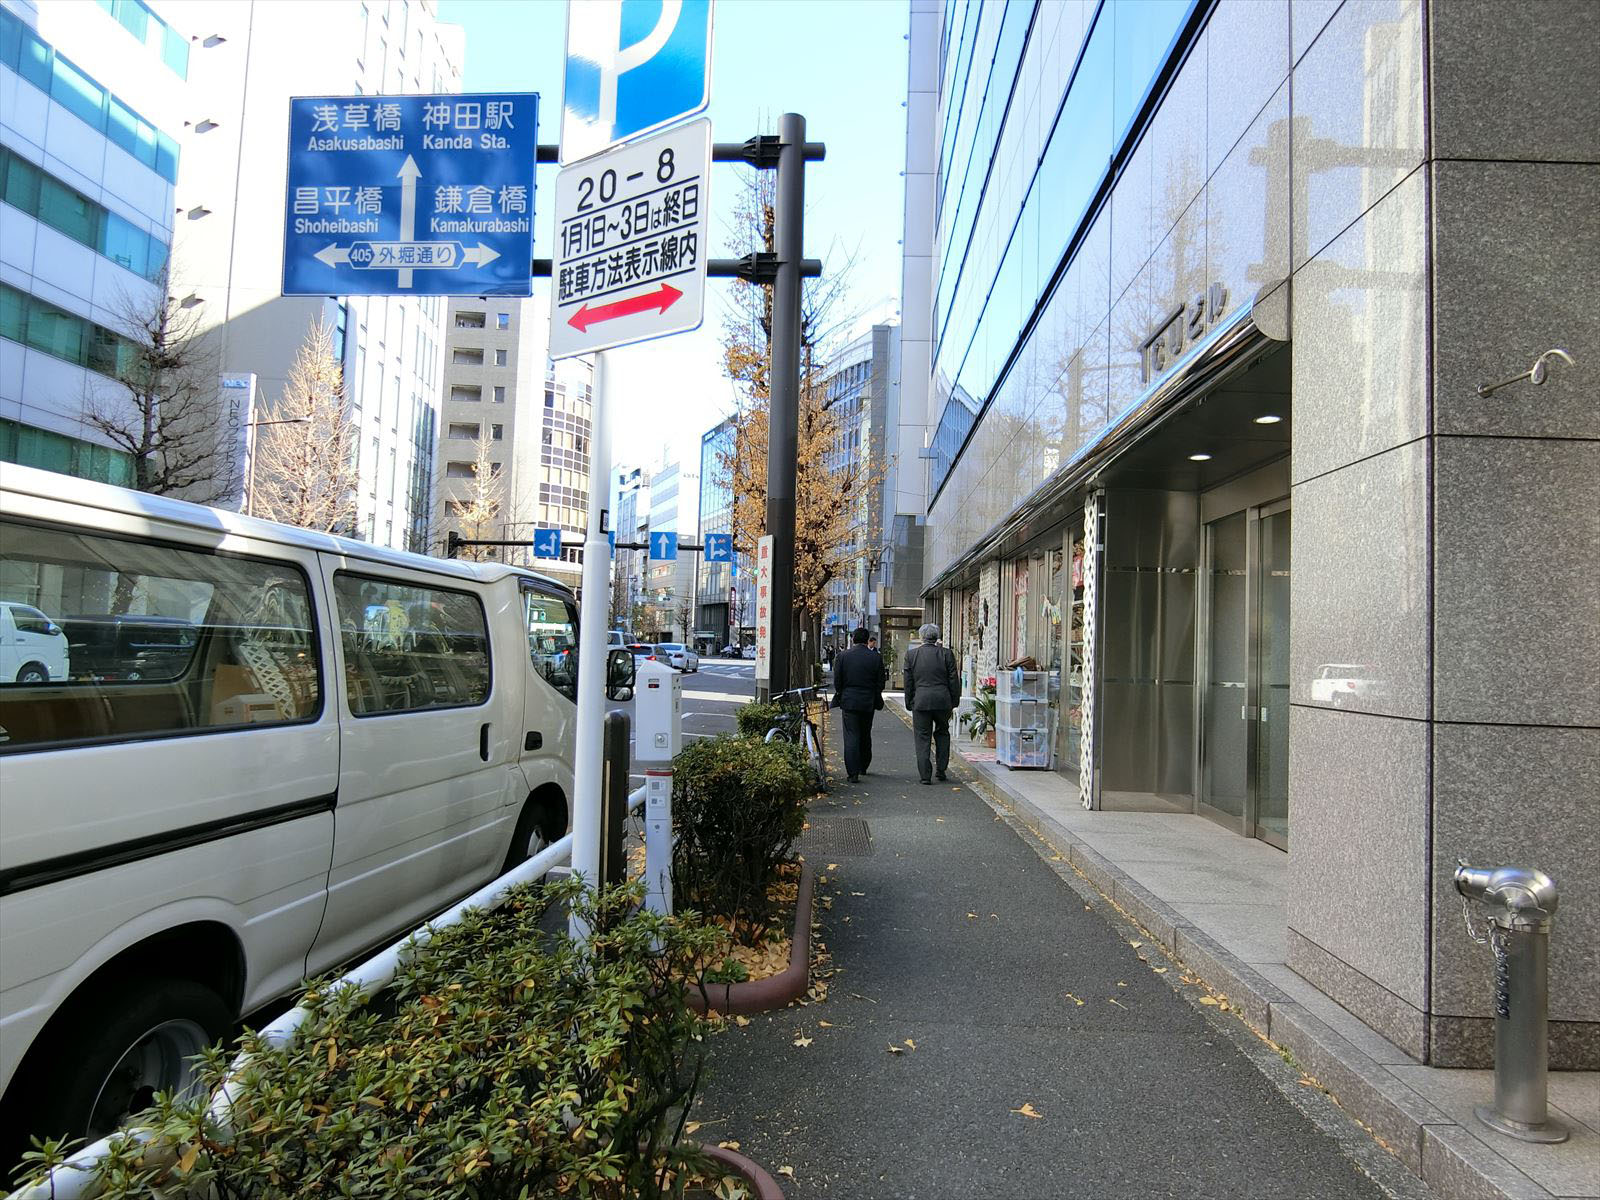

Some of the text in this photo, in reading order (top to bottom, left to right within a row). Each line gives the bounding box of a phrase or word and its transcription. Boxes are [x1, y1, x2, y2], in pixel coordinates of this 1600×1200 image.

[311, 103, 402, 132] 浅草橋
[422, 101, 514, 131] 神田駅
[307, 135, 404, 151] Asakusabashi
[423, 133, 511, 149] Kanda Sta.
[294, 186, 383, 215] 昌平橋
[434, 184, 528, 214] 鎌倉橋
[294, 218, 379, 234] Shoheibashi
[430, 217, 529, 233] Kamakurabashi
[351, 248, 372, 262] 405
[378, 246, 452, 264] 外堀通り
[558, 230, 698, 301] 駐車方法表示線内
[758, 545, 769, 659] 重大事故発生
